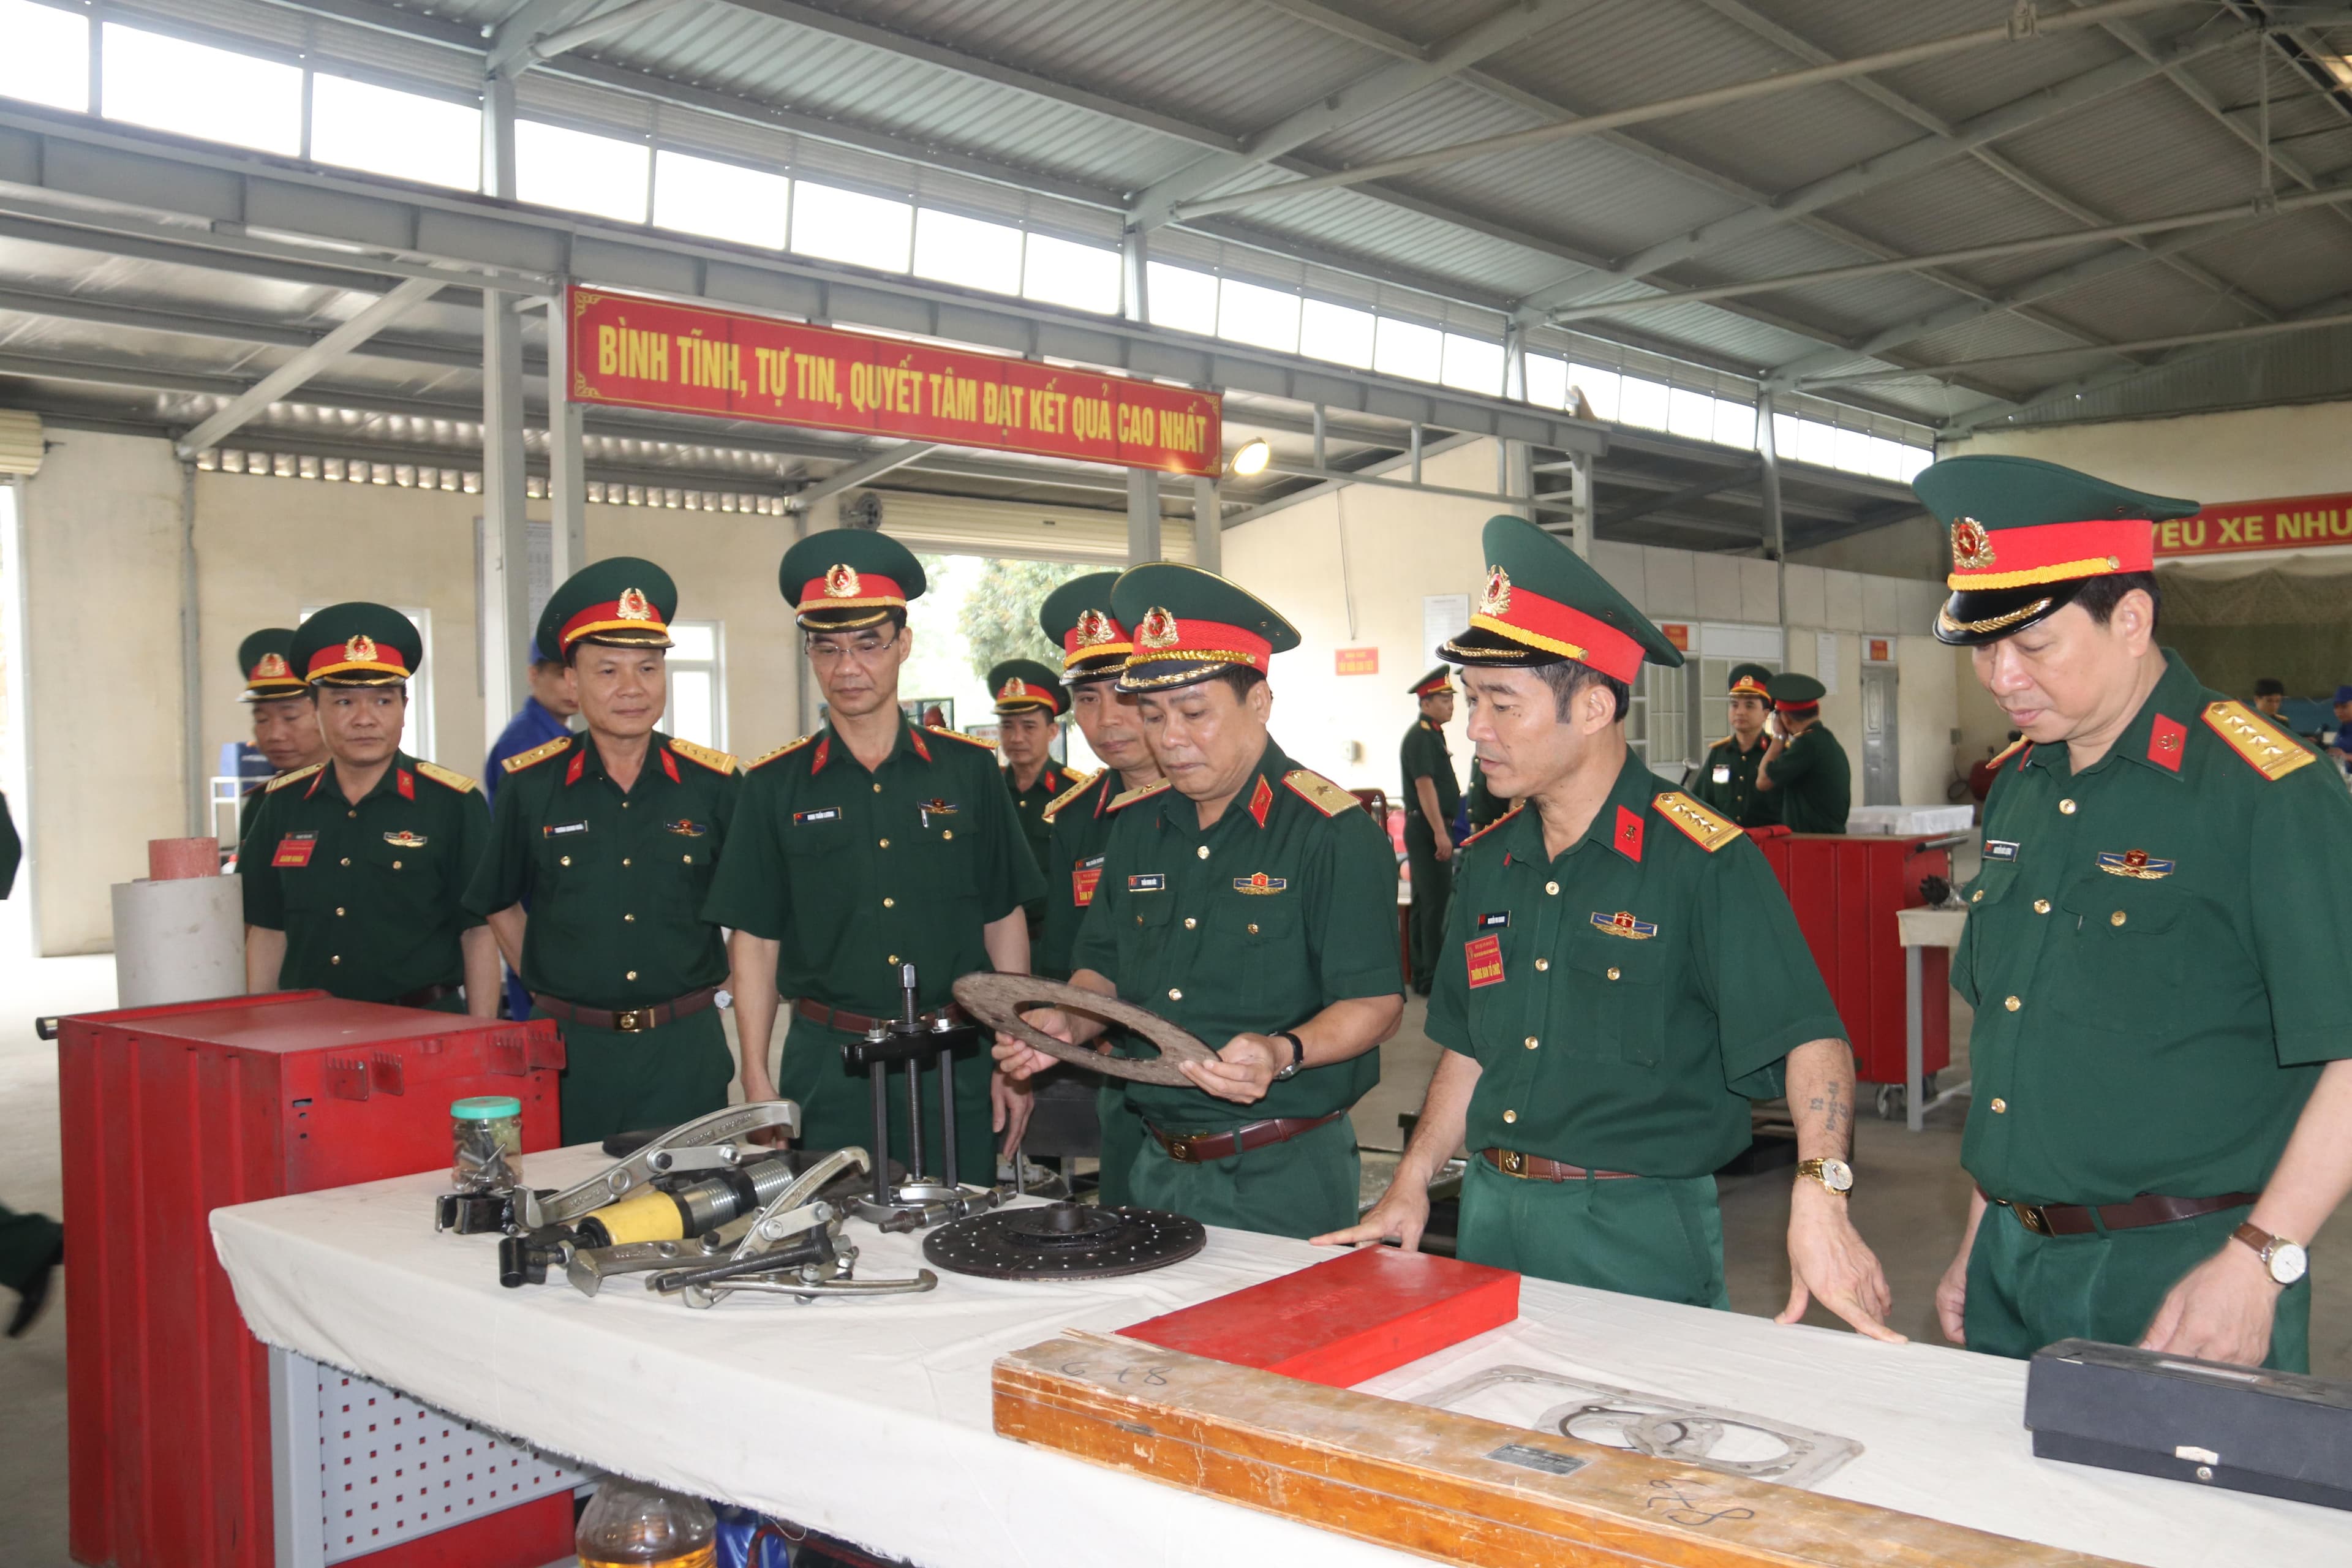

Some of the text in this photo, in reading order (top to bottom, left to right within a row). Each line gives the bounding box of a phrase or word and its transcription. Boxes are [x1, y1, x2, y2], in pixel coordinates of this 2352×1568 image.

[598, 317, 1207, 453] BÌNH TĨNH, TỰ TIN, QUYẾT TÂM ĐẠT KẾT QUẢ CAO NHẤT
[2217, 516, 2264, 544] XE
